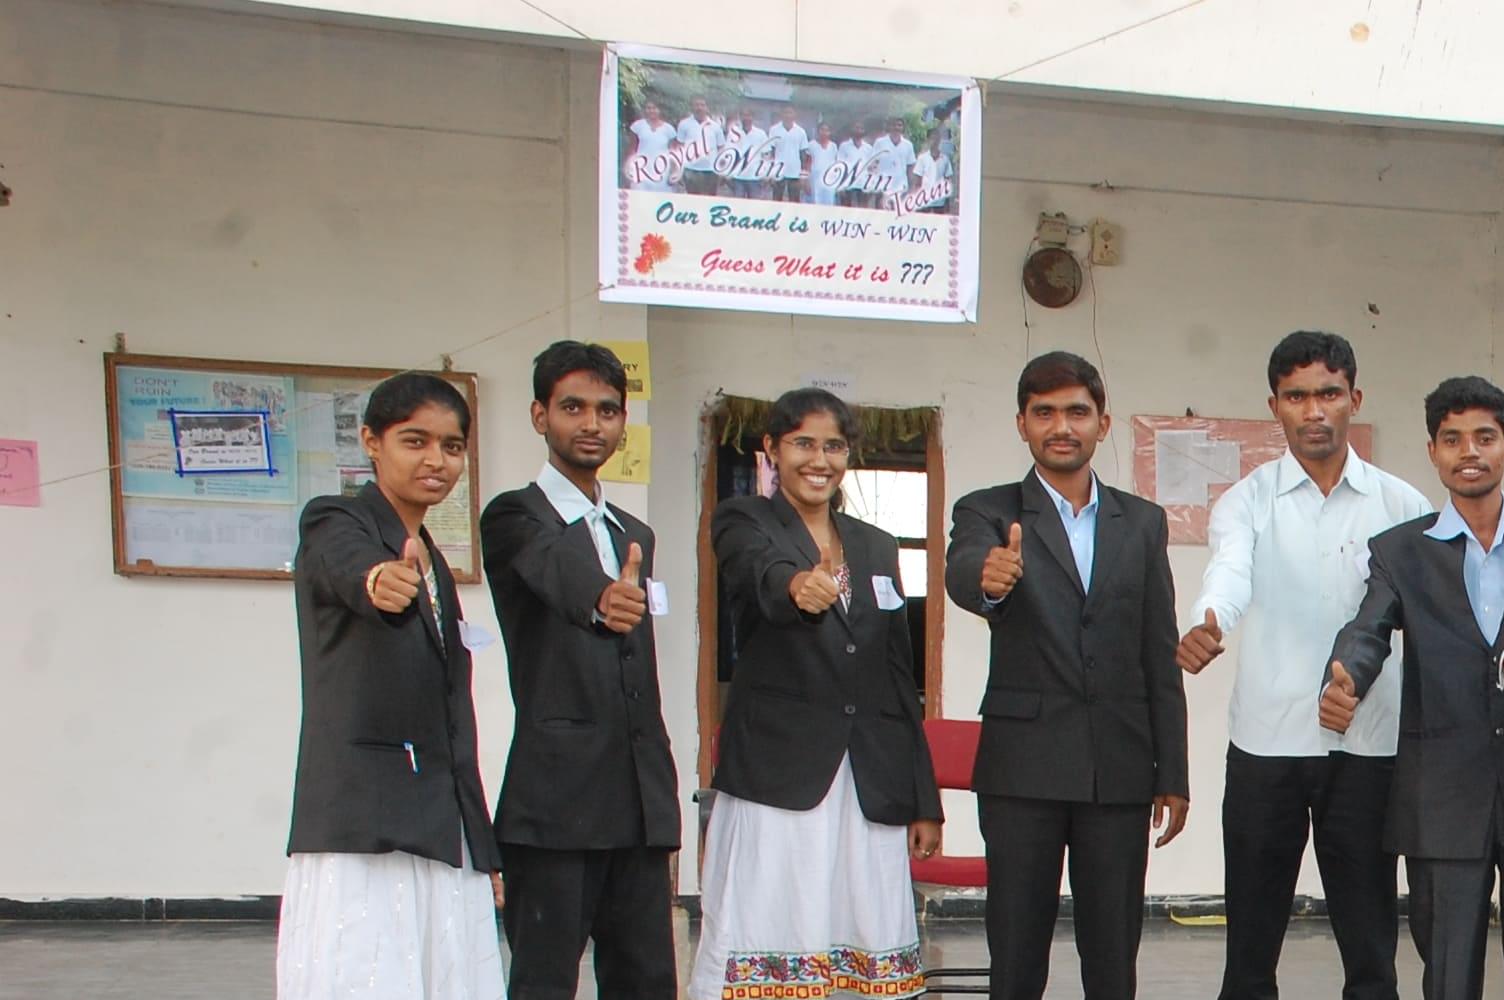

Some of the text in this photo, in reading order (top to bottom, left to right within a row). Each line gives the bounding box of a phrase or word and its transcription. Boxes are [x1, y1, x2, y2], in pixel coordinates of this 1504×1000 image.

[714, 136, 785, 178] Win
[823, 150, 892, 190] Win
[656, 201, 700, 225] Our
[709, 205, 782, 233] Brand
[788, 217, 809, 233] is
[821, 219, 871, 239] WIN
[887, 223, 937, 244] WIN
[701, 248, 935, 285] Guess What it is ???
